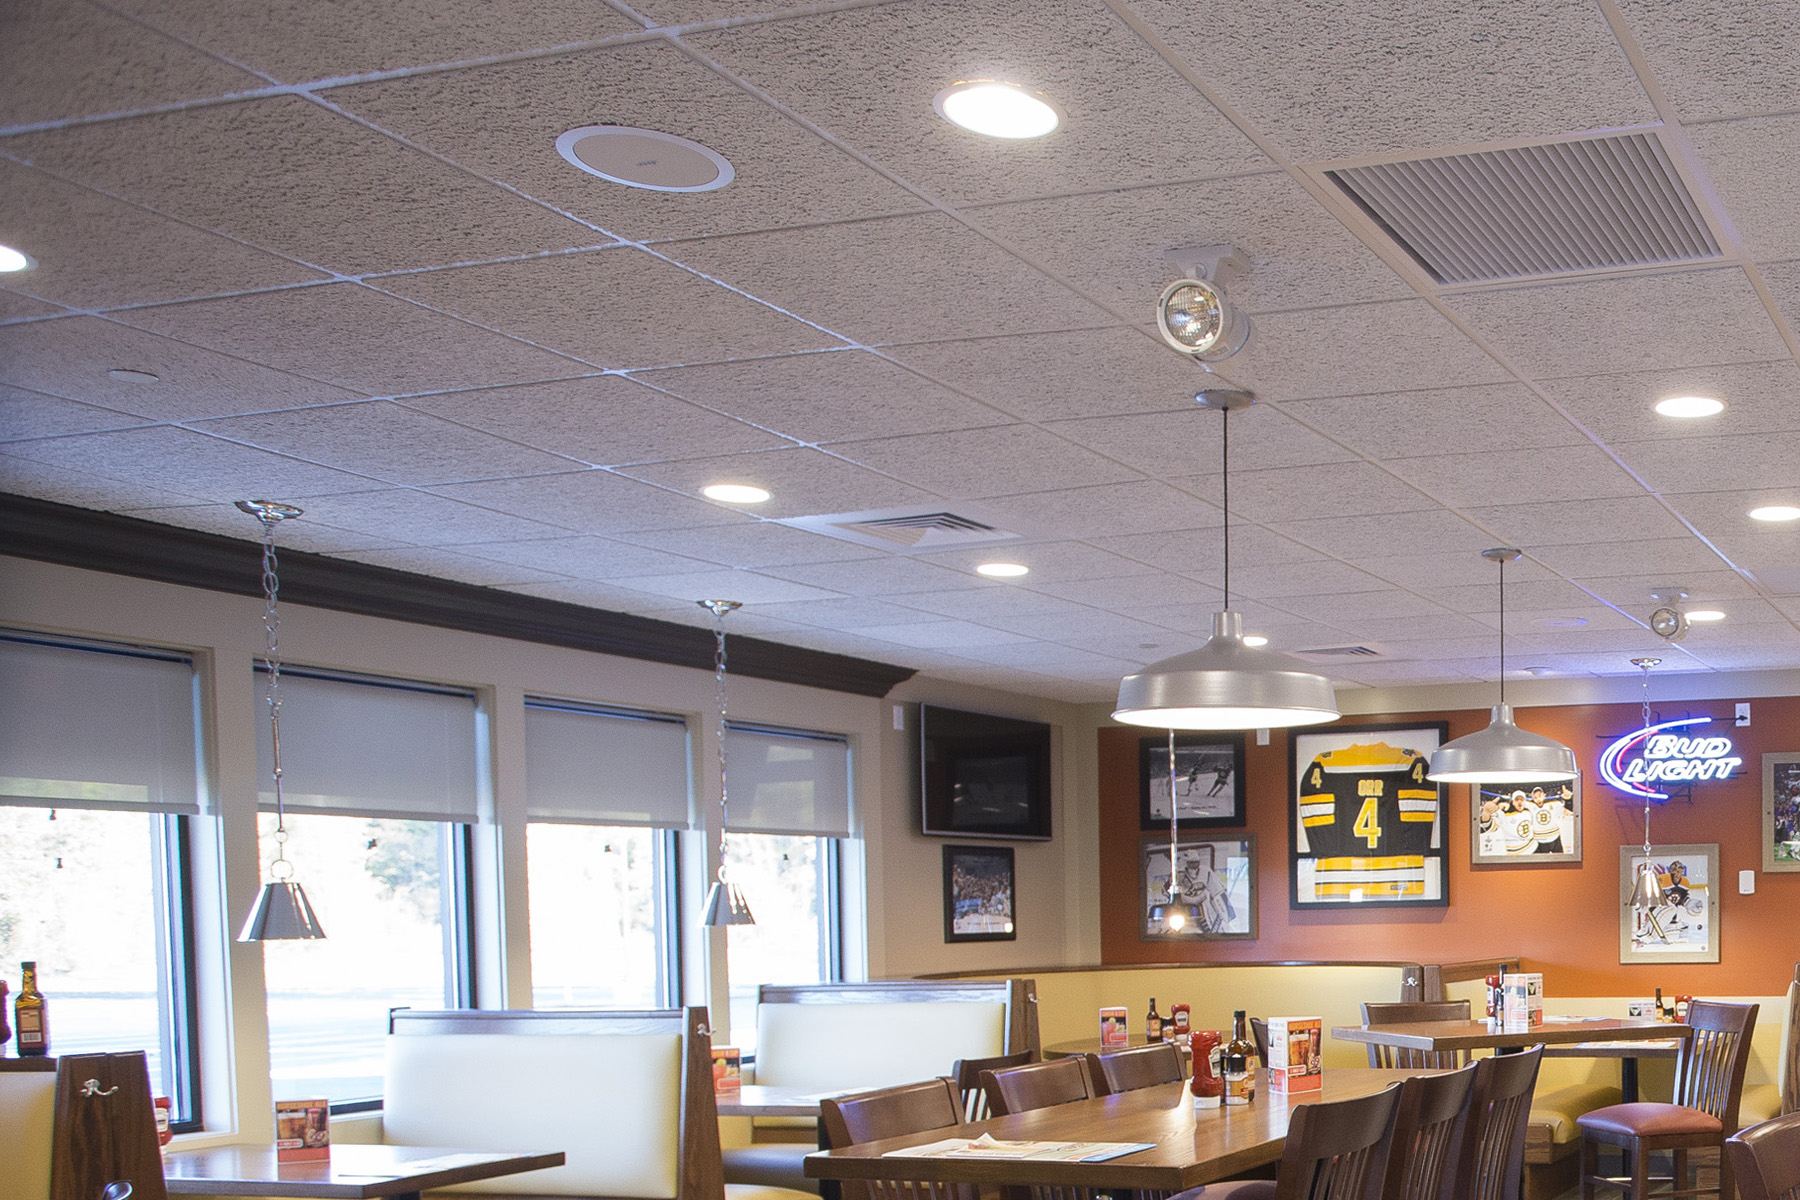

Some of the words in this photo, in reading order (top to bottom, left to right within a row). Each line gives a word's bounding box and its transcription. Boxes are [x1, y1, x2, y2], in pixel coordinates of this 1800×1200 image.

[1644, 734, 1732, 759] BUD
[1310, 767, 1323, 789] 4
[1411, 762, 1424, 784] 4
[1622, 757, 1743, 783] LIGHT
[1357, 779, 1384, 797] ORR
[1353, 797, 1382, 849] 4
